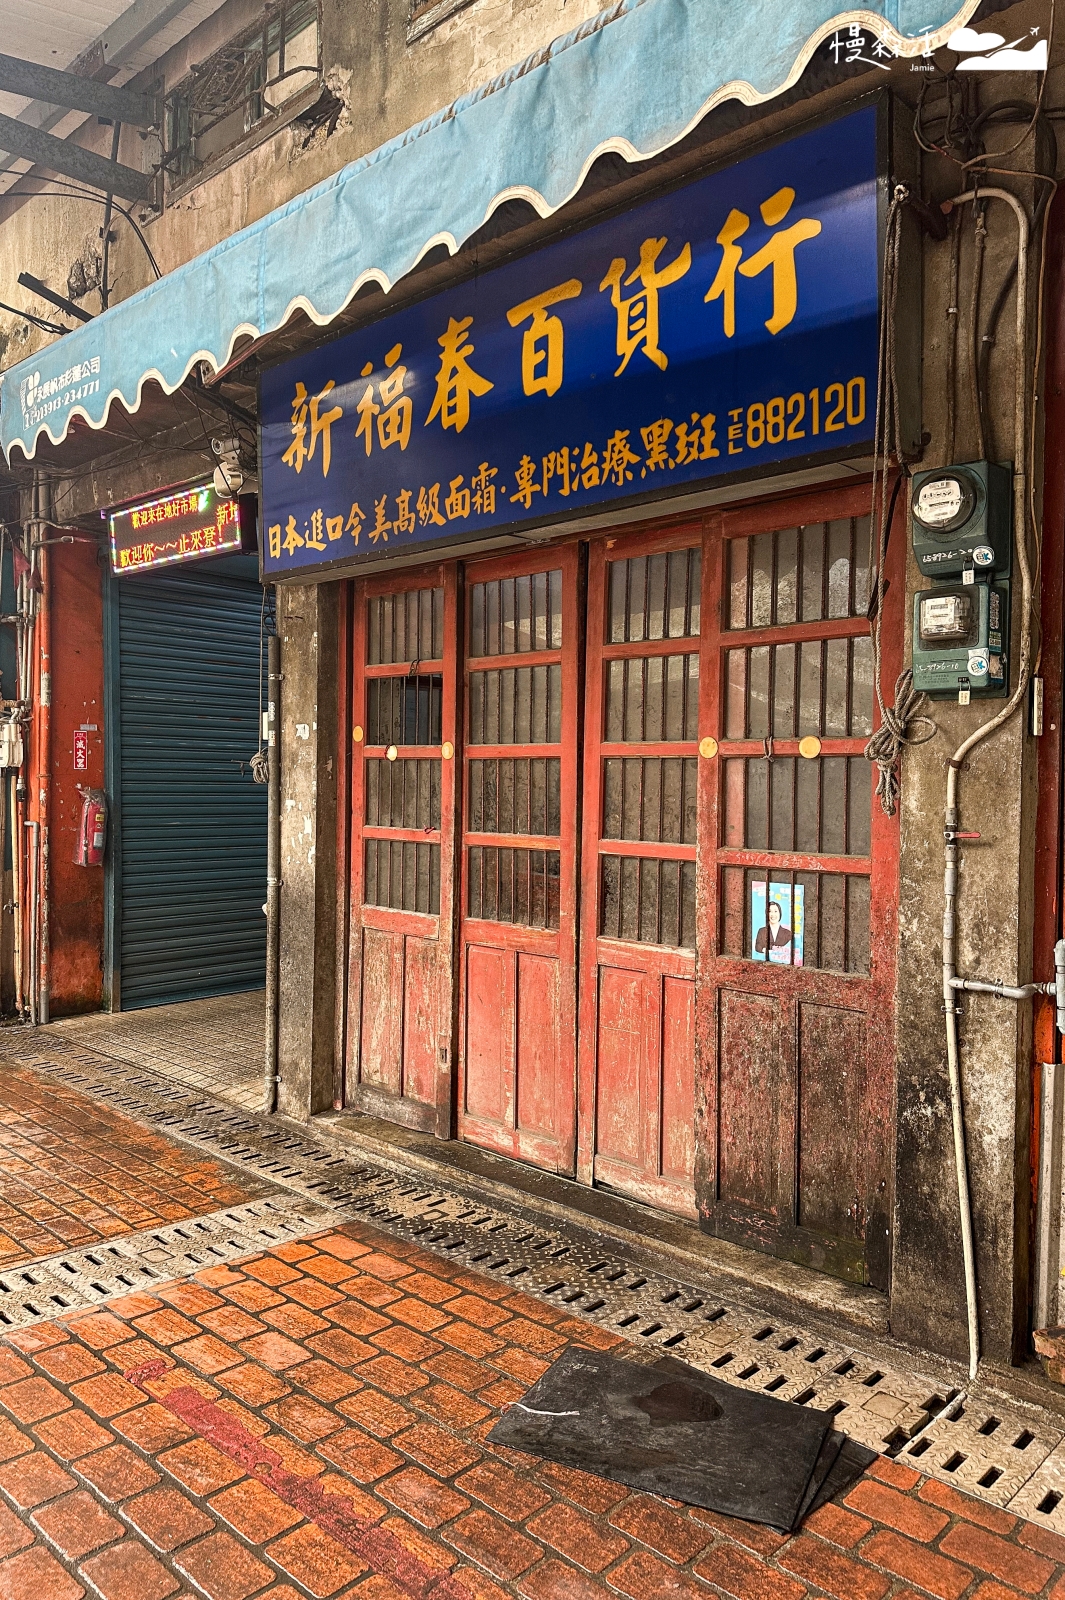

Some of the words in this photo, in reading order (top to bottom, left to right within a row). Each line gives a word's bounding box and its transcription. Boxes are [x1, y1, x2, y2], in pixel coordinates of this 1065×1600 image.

[281, 186, 822, 479] 新福春百貨行
[728, 407, 744, 455] TEL
[746, 375, 866, 448] 882120
